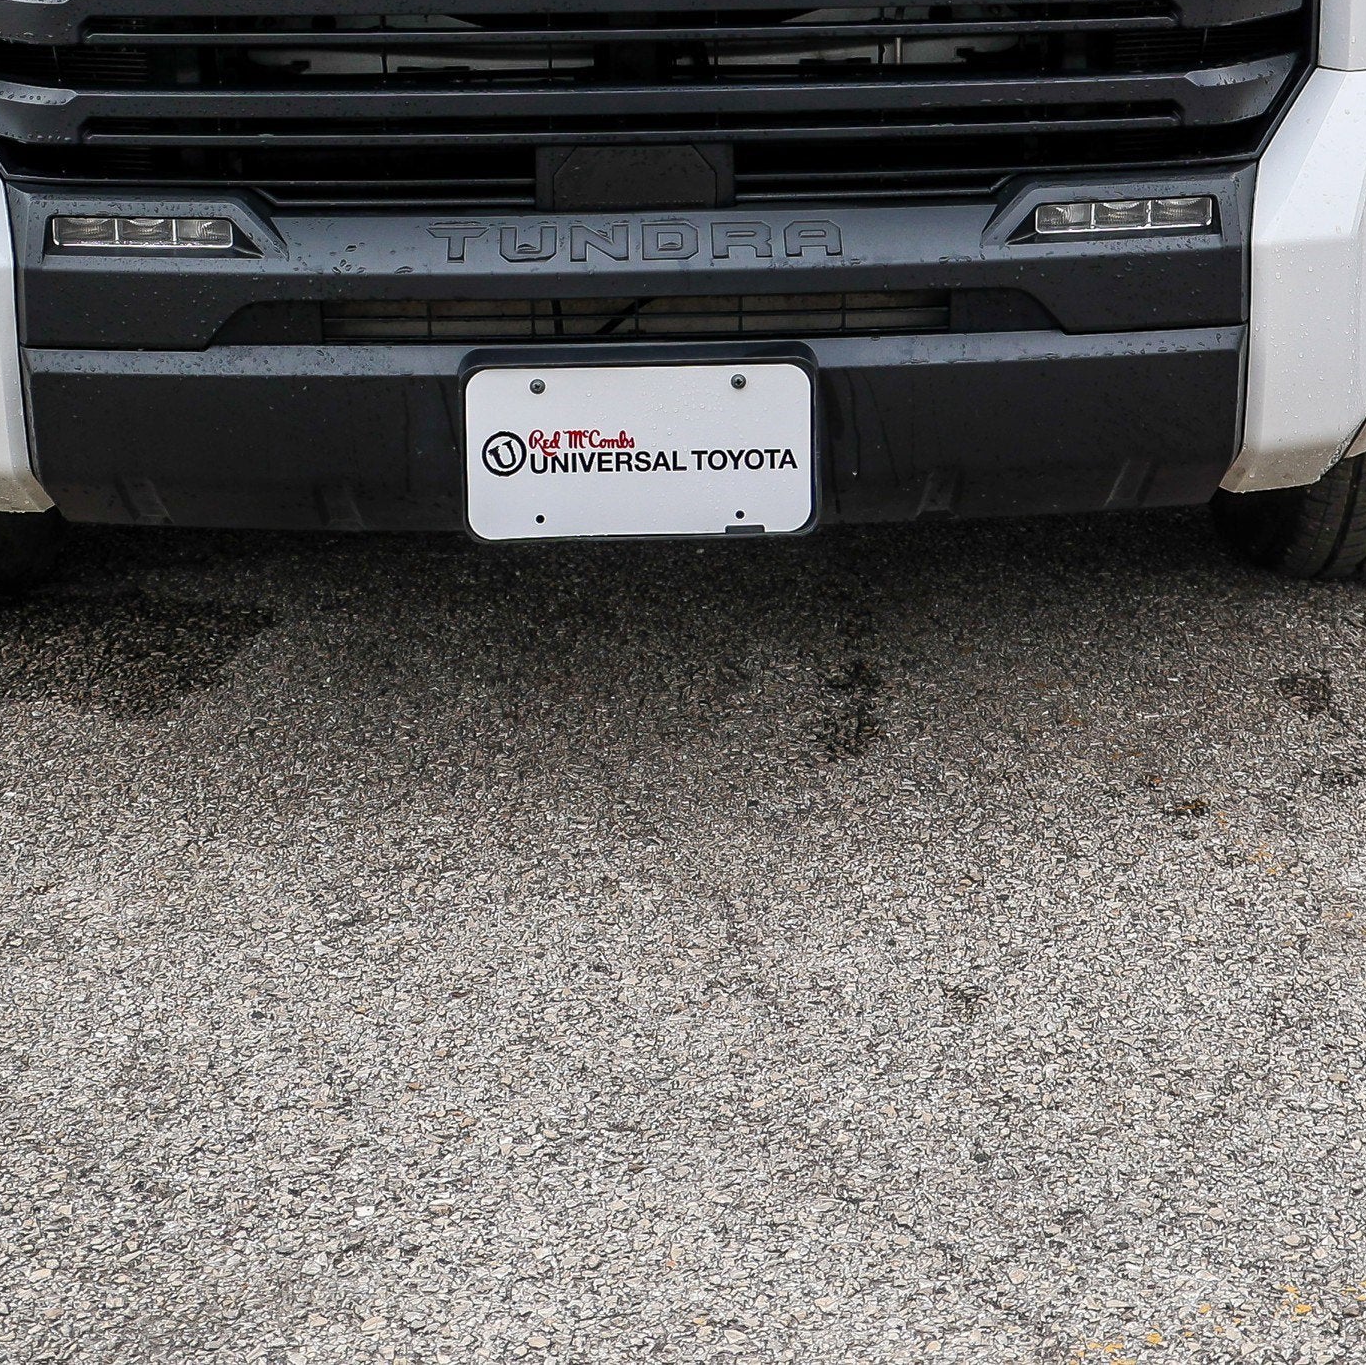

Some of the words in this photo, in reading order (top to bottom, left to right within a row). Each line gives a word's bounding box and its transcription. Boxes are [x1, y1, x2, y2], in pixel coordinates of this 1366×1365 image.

[426, 219, 844, 263] TUNDRA
[528, 429, 561, 457] Red
[562, 429, 636, 450] McCombs
[530, 449, 687, 475] UNIVERSAL
[691, 447, 798, 471] TOYOTA
